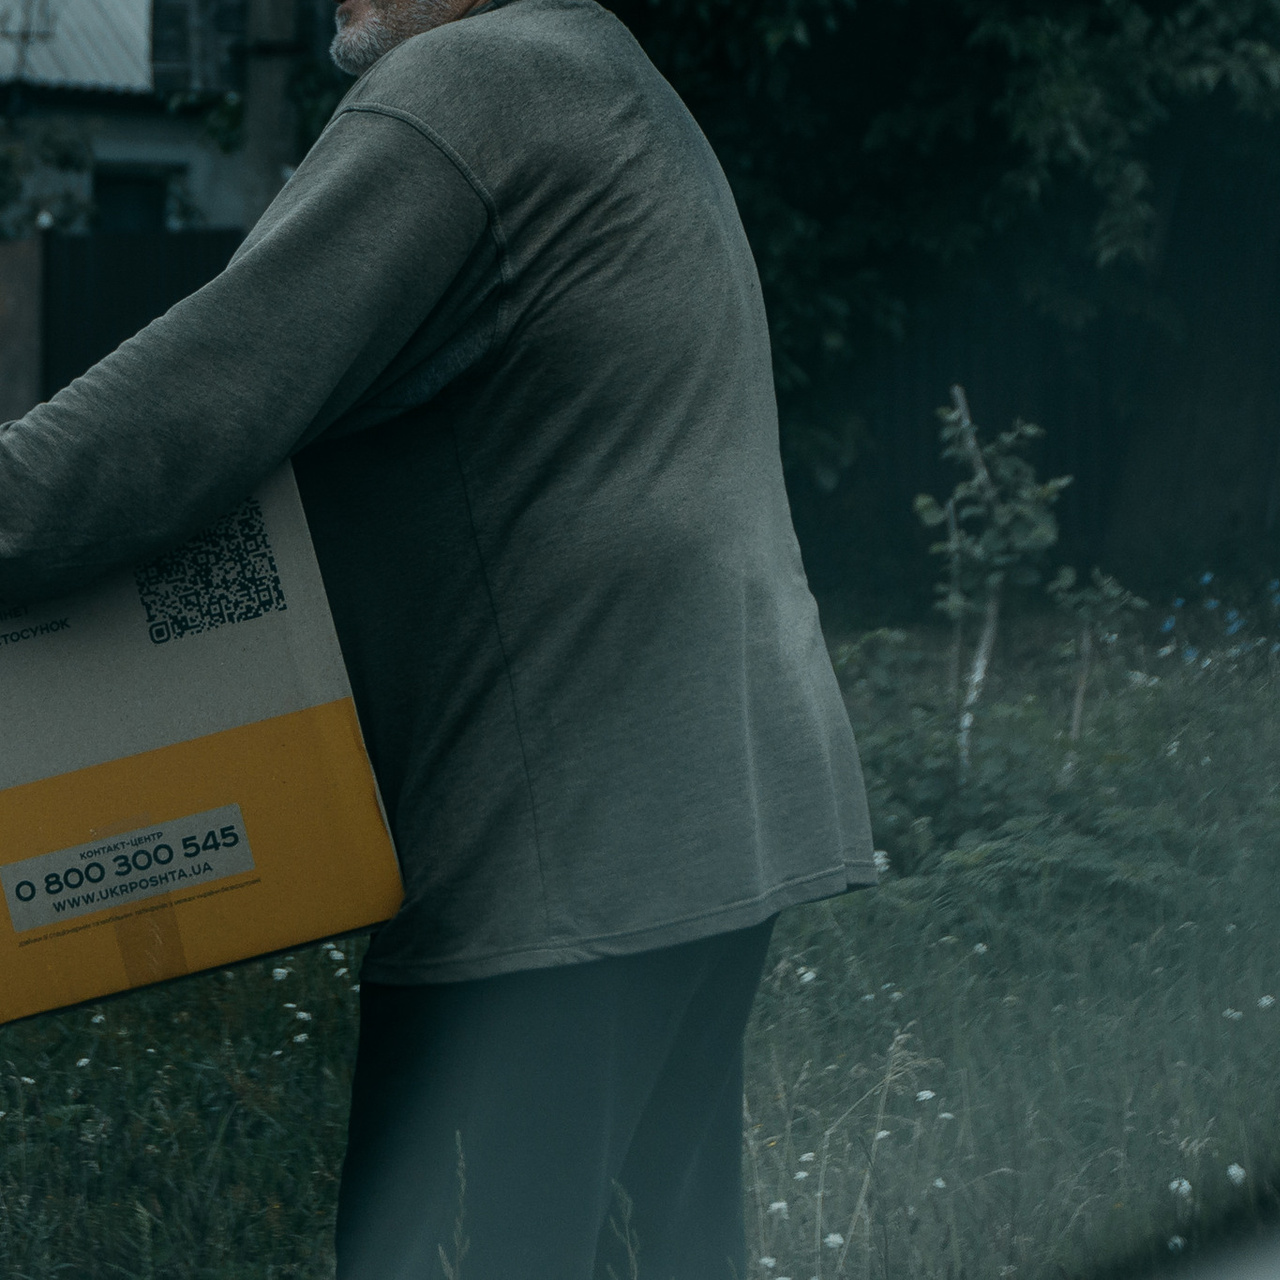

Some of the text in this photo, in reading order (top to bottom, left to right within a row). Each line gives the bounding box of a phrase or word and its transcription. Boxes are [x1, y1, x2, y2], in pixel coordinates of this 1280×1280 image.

[15, 825, 240, 902] 0 800 300 545
[79, 831, 164, 861] КОНТАКТ-ЦЕНТР
[52, 861, 214, 913] WWW.UKRPOSHTA.UA
